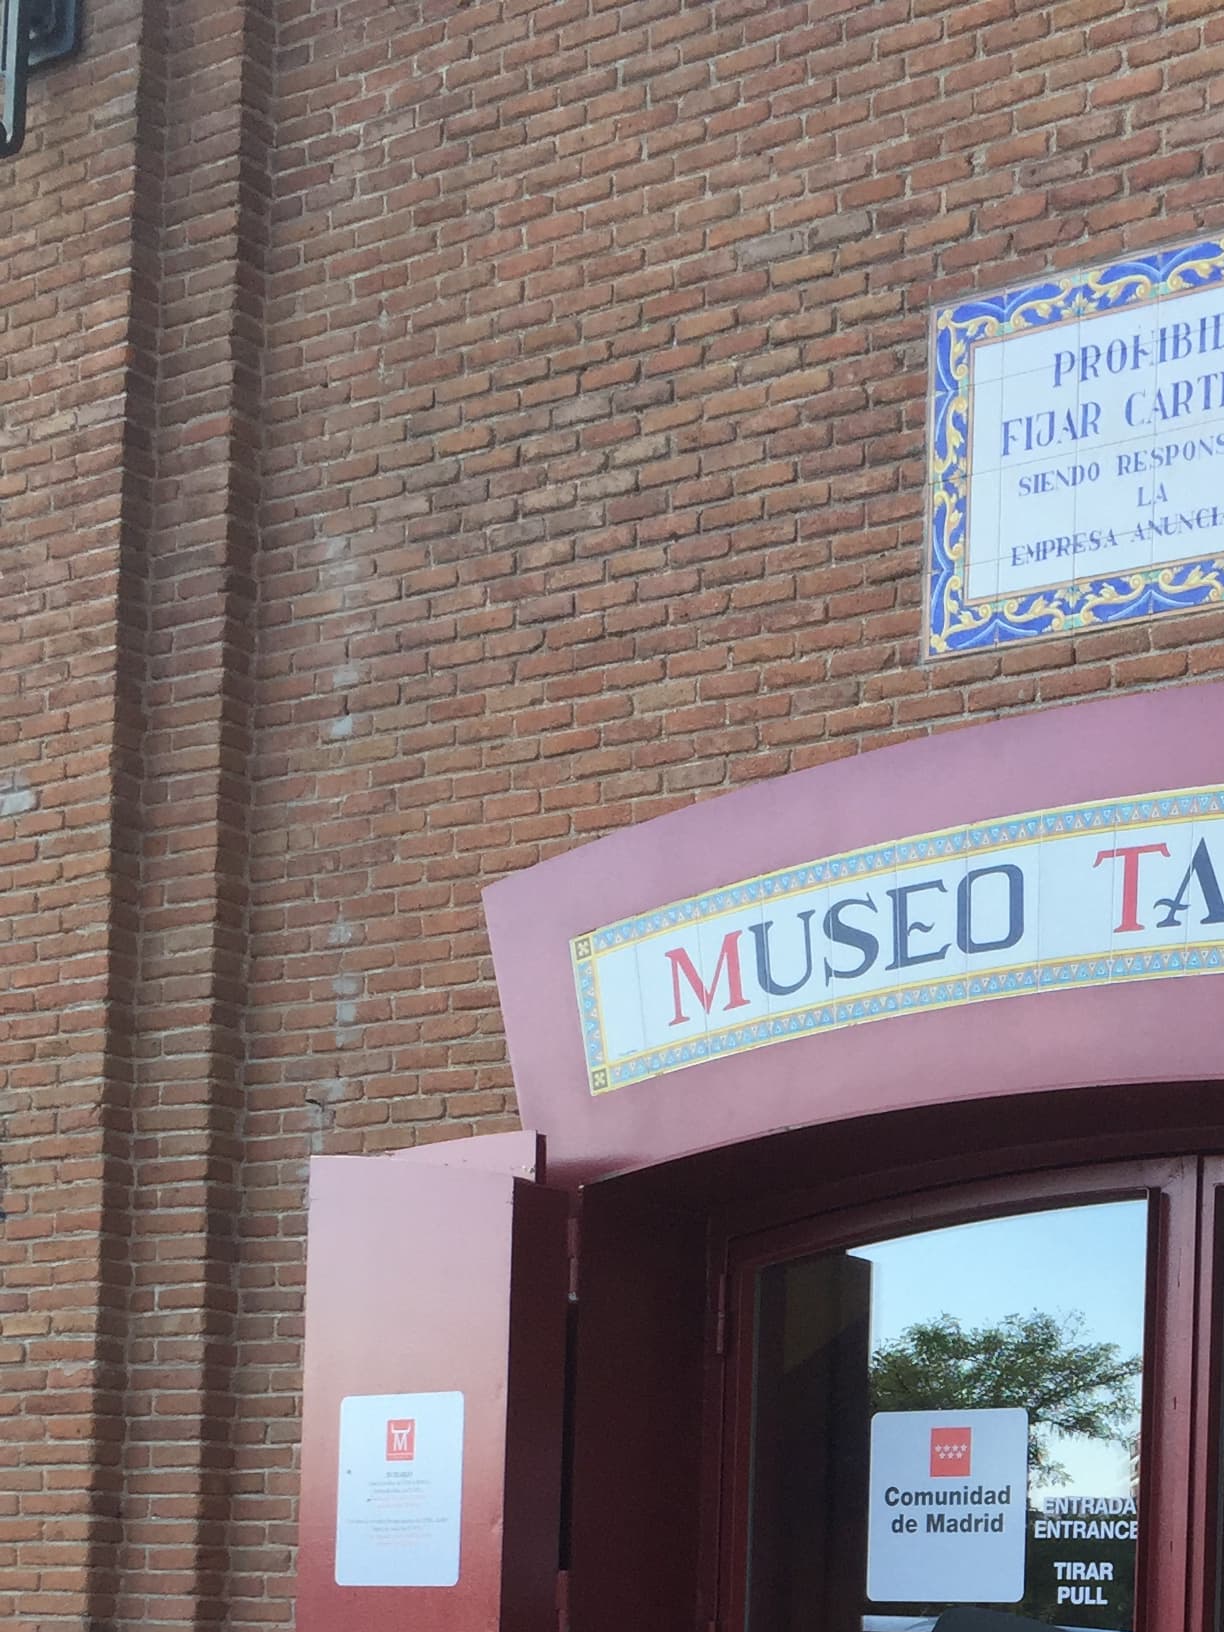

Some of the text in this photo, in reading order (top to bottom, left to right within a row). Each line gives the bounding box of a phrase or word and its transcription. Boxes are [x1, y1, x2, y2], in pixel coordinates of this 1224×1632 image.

[1000, 401, 1101, 457] FIJAR
[1018, 461, 1100, 497] SIENDO
[1136, 482, 1169, 507] LA
[1010, 528, 1119, 567] EMPRESA
[664, 862, 1025, 1027] MUSEO
[884, 1485, 1011, 1507] Comunidad
[1043, 1497, 1137, 1515] ENTRADA
[891, 1513, 1004, 1533] de Madrid
[1034, 1520, 1138, 1539] ENTRANCE
[1053, 1562, 1114, 1580] TIRAR
[1057, 1586, 1108, 1605] PULL
